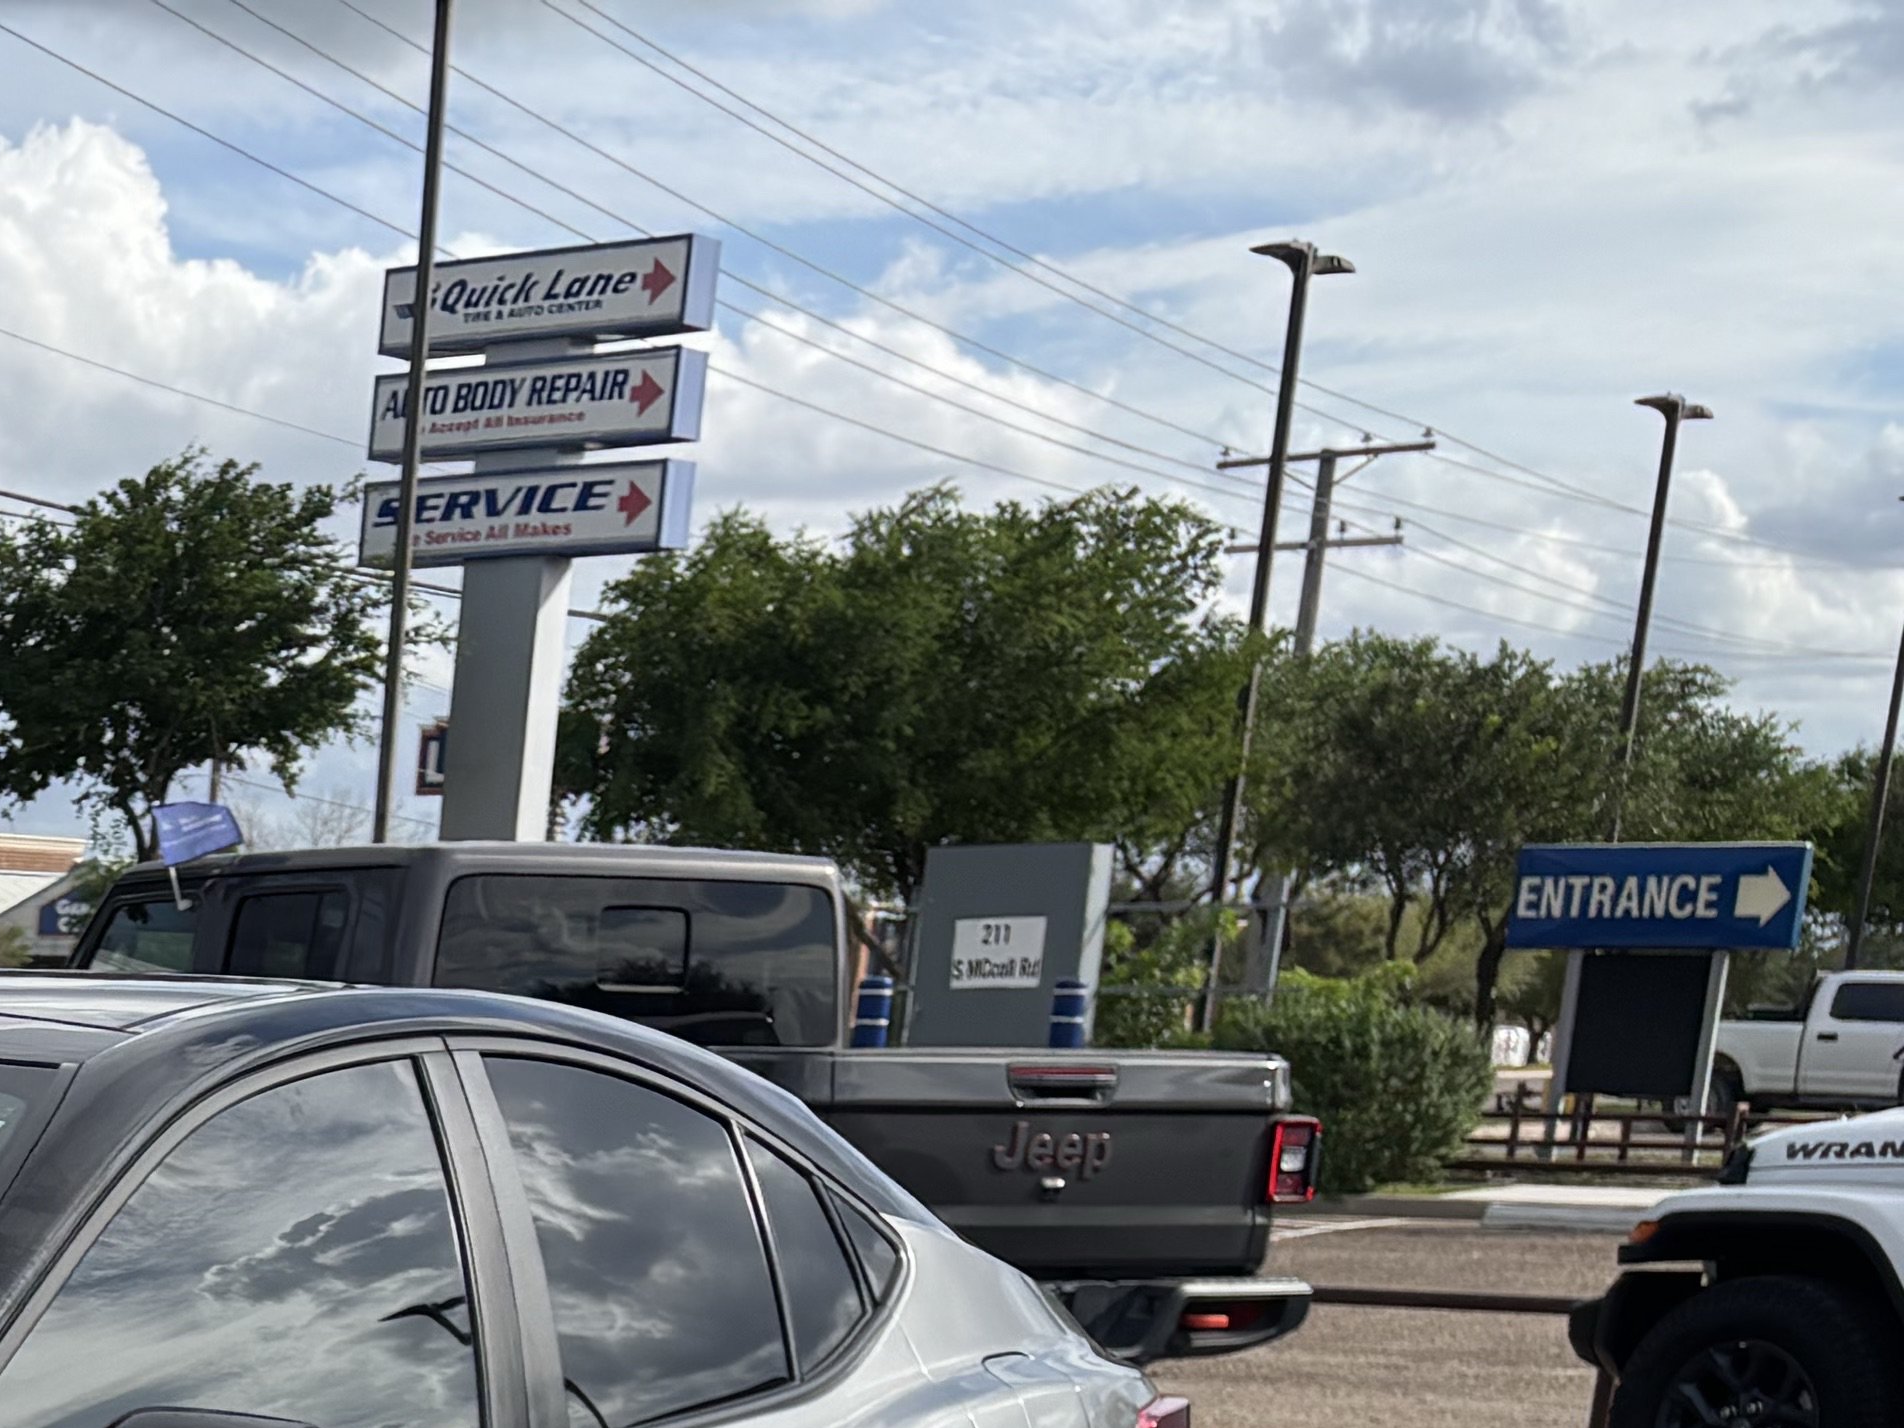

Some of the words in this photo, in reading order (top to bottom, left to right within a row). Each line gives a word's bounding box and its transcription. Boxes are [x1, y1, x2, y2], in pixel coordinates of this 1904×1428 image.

[440, 272, 539, 314] Quick
[542, 269, 638, 300] Lane
[547, 299, 603, 314] CENTER
[451, 377, 527, 413] BODY
[525, 369, 630, 407] REPAIR
[371, 480, 616, 527] SERVICE
[425, 526, 482, 545] Service
[485, 524, 509, 540] All
[513, 521, 572, 537] Makes
[1516, 874, 1723, 919] ENTRANCE
[981, 924, 1012, 945] 211
[993, 1120, 1112, 1180] Jeep
